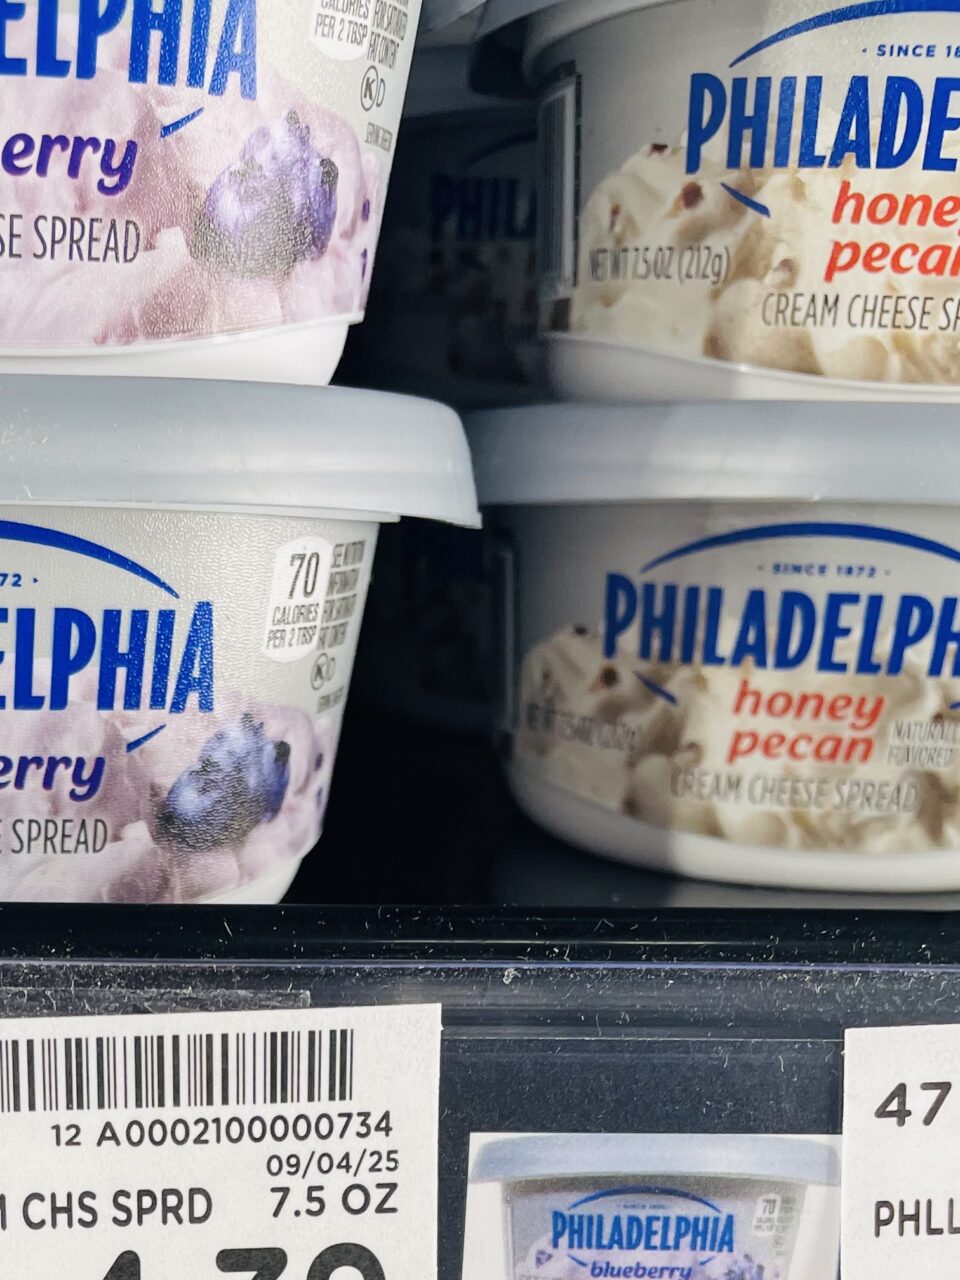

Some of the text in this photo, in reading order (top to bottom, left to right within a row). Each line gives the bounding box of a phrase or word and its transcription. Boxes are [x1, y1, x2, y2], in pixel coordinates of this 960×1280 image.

[314, 13, 369, 48] PER 2 TBSP
[876, 43, 937, 58] SINCE
[685, 72, 960, 175] PHILADE
[831, 180, 960, 237] hone
[32, 213, 141, 264] SPREAD
[761, 292, 930, 331] CREAM CHEESE
[288, 551, 321, 600] 70
[271, 602, 321, 627] CALORIES
[603, 572, 960, 679] PHILADELPH
[731, 679, 886, 731] honey
[725, 728, 876, 765] pecan
[669, 770, 919, 814] CREAM CHEESE SPREAD
[11, 818, 109, 855] SPREAD
[873, 1080, 953, 1127] 47
[51, 1111, 394, 1148] 12 A0002100000734
[266, 1149, 401, 1180] 09/04/25
[21, 1190, 99, 1231] CHS
[111, 1187, 214, 1228] SPRD
[269, 1185, 327, 1219] 7.5
[341, 1182, 399, 1216] OZ
[874, 1197, 960, 1238] PHLL
[551, 1210, 735, 1254] PHILADELPHIA
